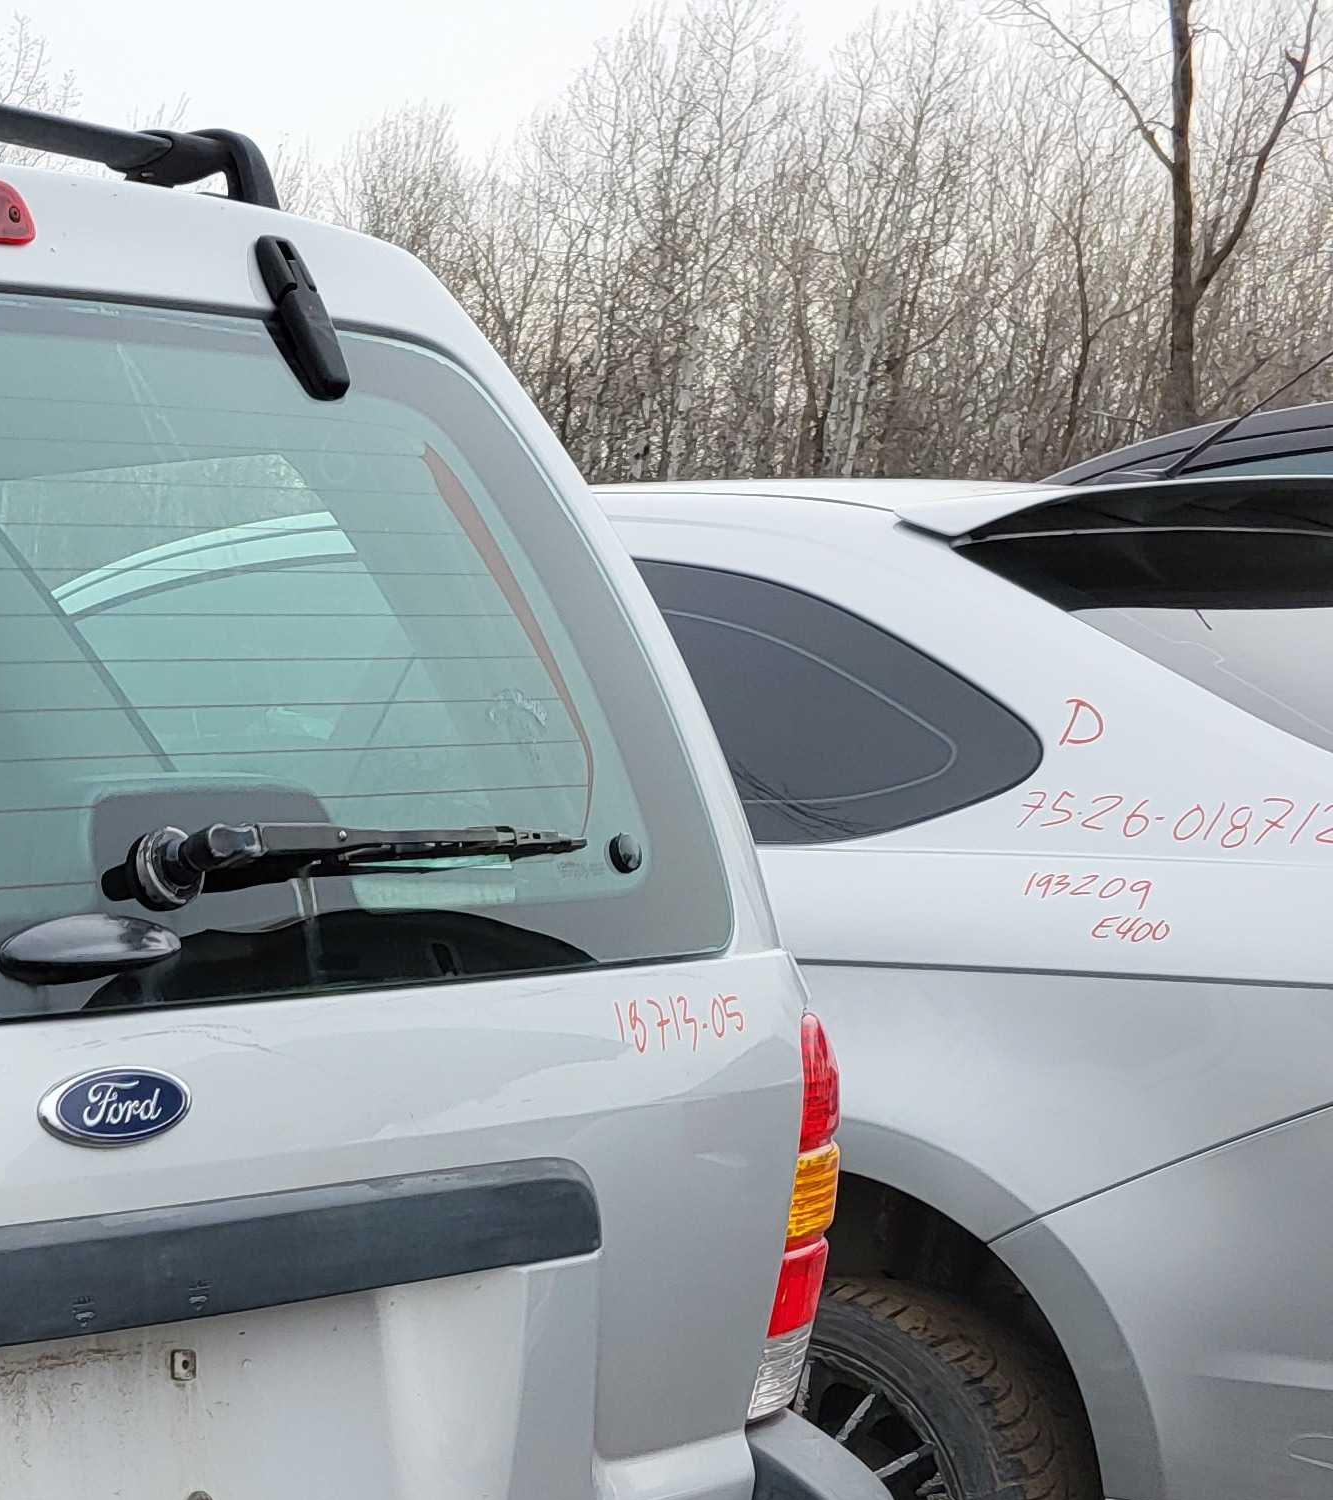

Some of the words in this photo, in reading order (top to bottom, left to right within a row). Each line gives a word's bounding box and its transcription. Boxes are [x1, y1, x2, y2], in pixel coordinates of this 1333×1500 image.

[1059, 697, 1105, 746] D
[1024, 871, 1153, 911] 193209
[1091, 915, 1171, 943] E400
[83, 1079, 163, 1128] Ford
